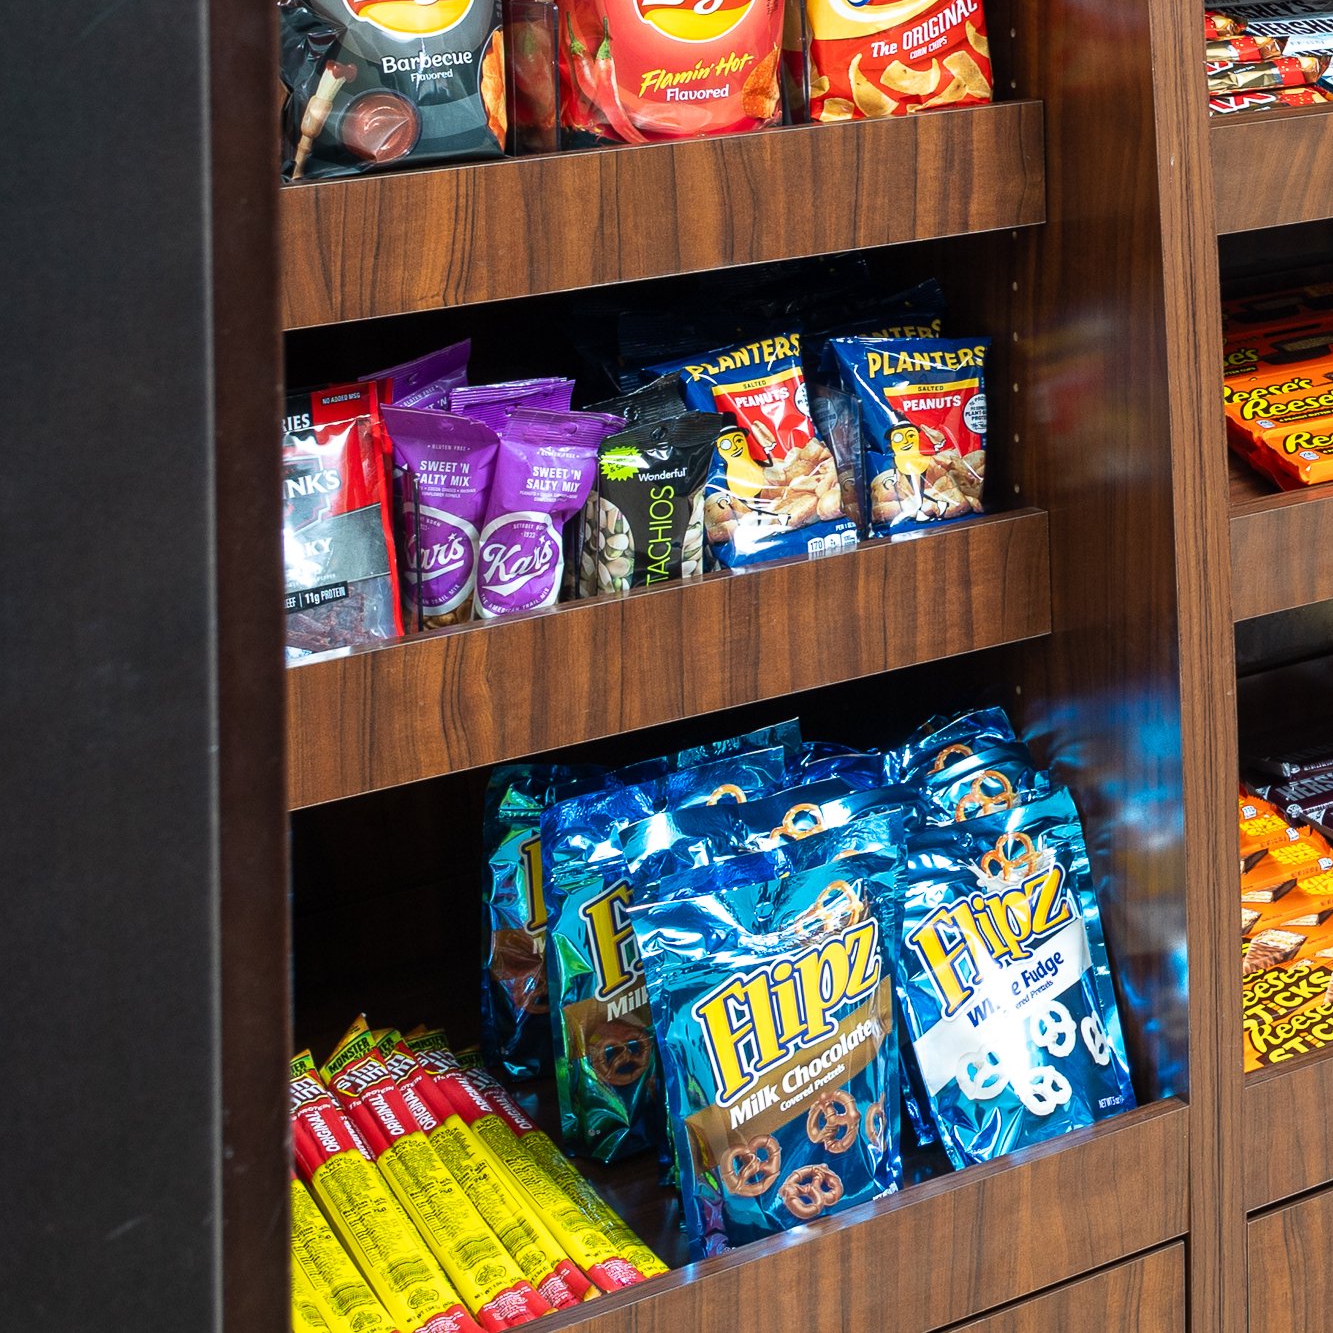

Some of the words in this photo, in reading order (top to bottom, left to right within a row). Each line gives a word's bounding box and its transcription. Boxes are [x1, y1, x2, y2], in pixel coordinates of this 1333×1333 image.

[871, 40, 898, 59] The
[382, 50, 473, 75] Barbecue
[410, 69, 453, 82] Flavored
[665, 84, 729, 102] Flavored
[685, 332, 801, 382] PLANTERS
[866, 345, 987, 379] PLANTERS
[743, 380, 767, 389] SALTED
[735, 386, 790, 409] PEANUTS
[902, 395, 962, 412] PEANUTS
[419, 459, 458, 473] SWEET
[460, 462, 470, 474] 'N
[533, 466, 569, 479] SWEET
[570, 469, 582, 481] 'N
[638, 467, 687, 482] Wonderful
[450, 474, 471, 487] MIX
[526, 478, 559, 491] SALTY
[562, 481, 581, 493] MIX
[913, 867, 1070, 1017] Flipz
[1021, 950, 1065, 988] Fudge
[696, 918, 880, 1102] Flipz
[328, 1036, 371, 1073] MONSTER
[730, 1084, 779, 1131] Milk
[781, 1017, 875, 1092] Chocolate
[306, 1110, 341, 1153] ORIGINAL
